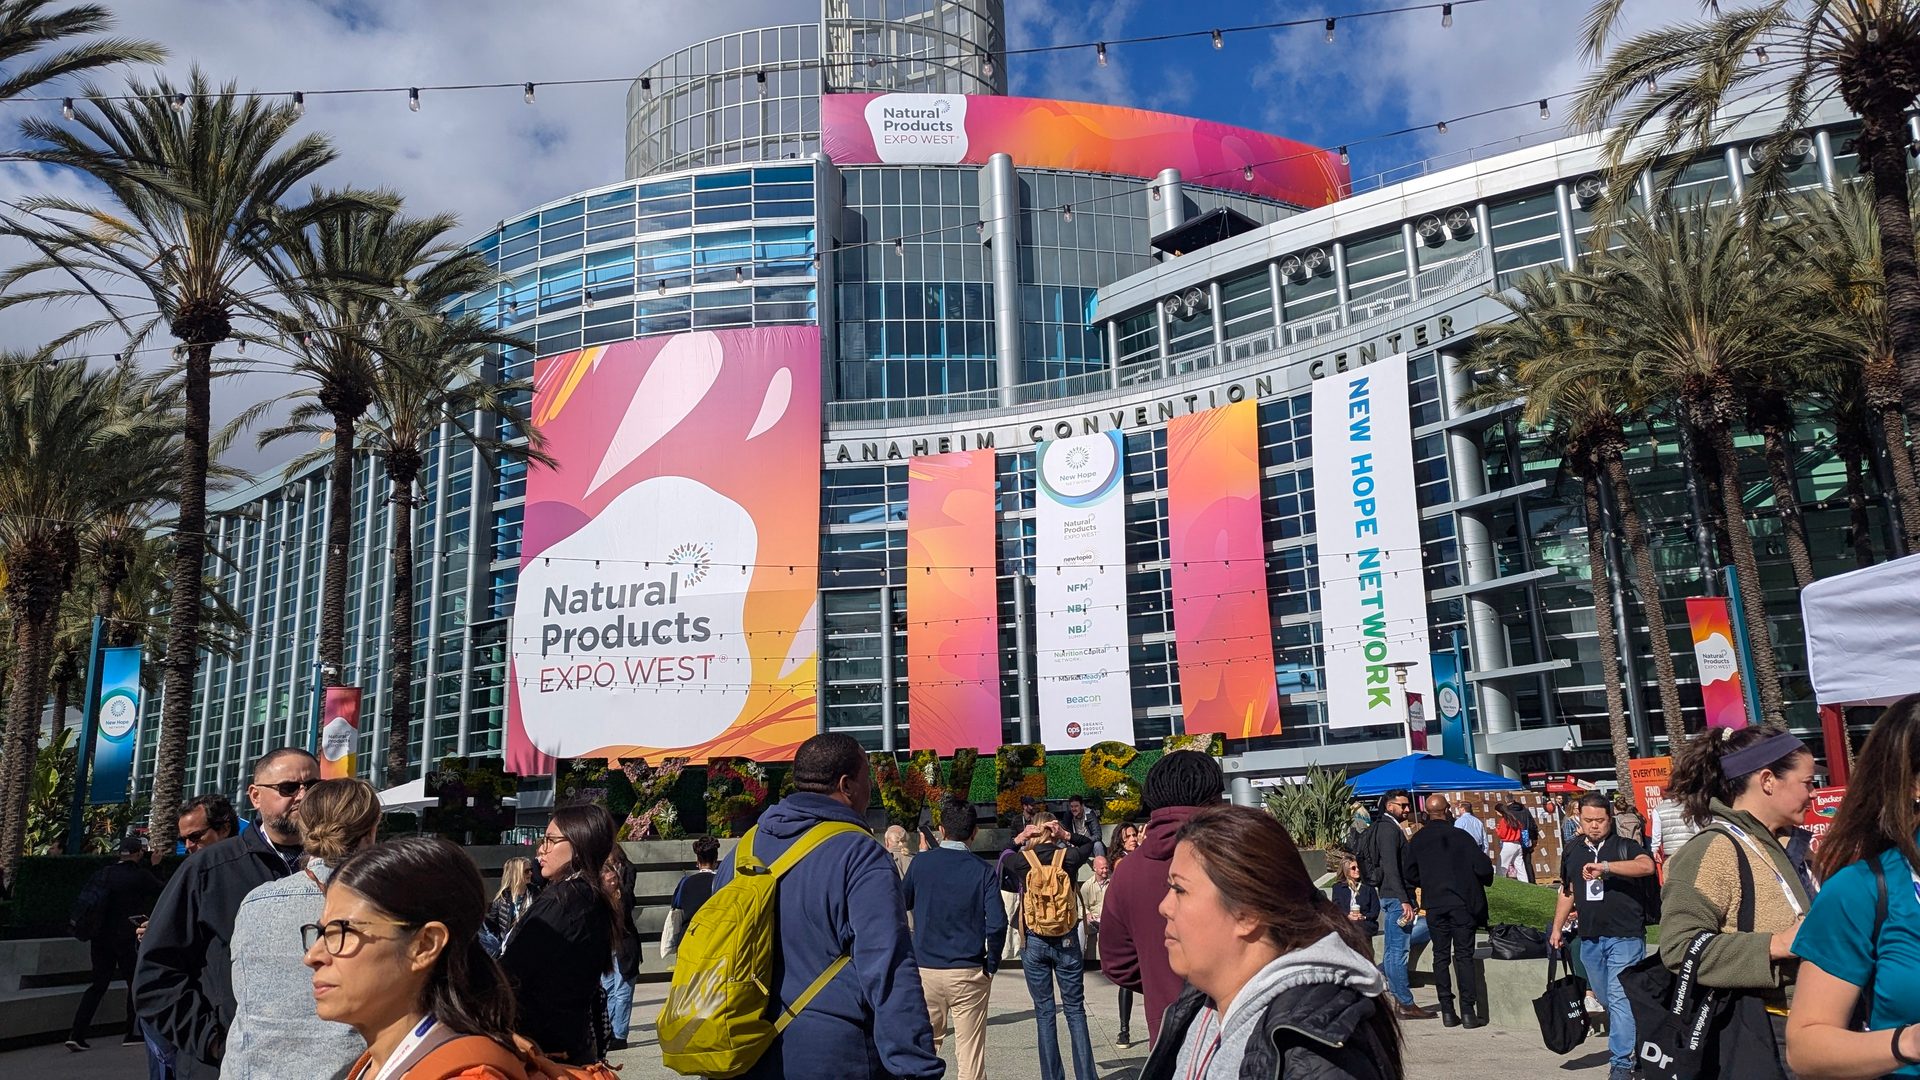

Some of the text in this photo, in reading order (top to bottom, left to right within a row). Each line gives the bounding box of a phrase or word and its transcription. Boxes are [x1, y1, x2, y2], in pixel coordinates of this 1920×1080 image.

[883, 107, 940, 119] Natural
[884, 120, 953, 132] Products
[884, 135, 918, 144] EXPO
[836, 314, 1455, 462] ANAHEIM CONVENTION CENTER
[1060, 471, 1097, 482] New Hope
[1064, 518, 1091, 527] Natural
[1064, 524, 1097, 534] Products
[1349, 376, 1392, 711] NEW HOPE NETWORK
[1063, 554, 1093, 563] newtopia
[1067, 583, 1088, 592] NFM
[543, 572, 679, 618] Natural
[541, 612, 711, 656] Products
[1068, 625, 1087, 634] NBJ
[540, 661, 615, 693] EXPO
[1066, 694, 1101, 704] Beacon
[1645, 786, 1661, 796] FIND
[1816, 796, 1843, 805] Loacker
[1672, 959, 1693, 1015] Hydration is Life
[1696, 1004, 1710, 1031] Hydration
[1689, 1036, 1699, 1051] Life
[1640, 1041, 1674, 1070] Dr
